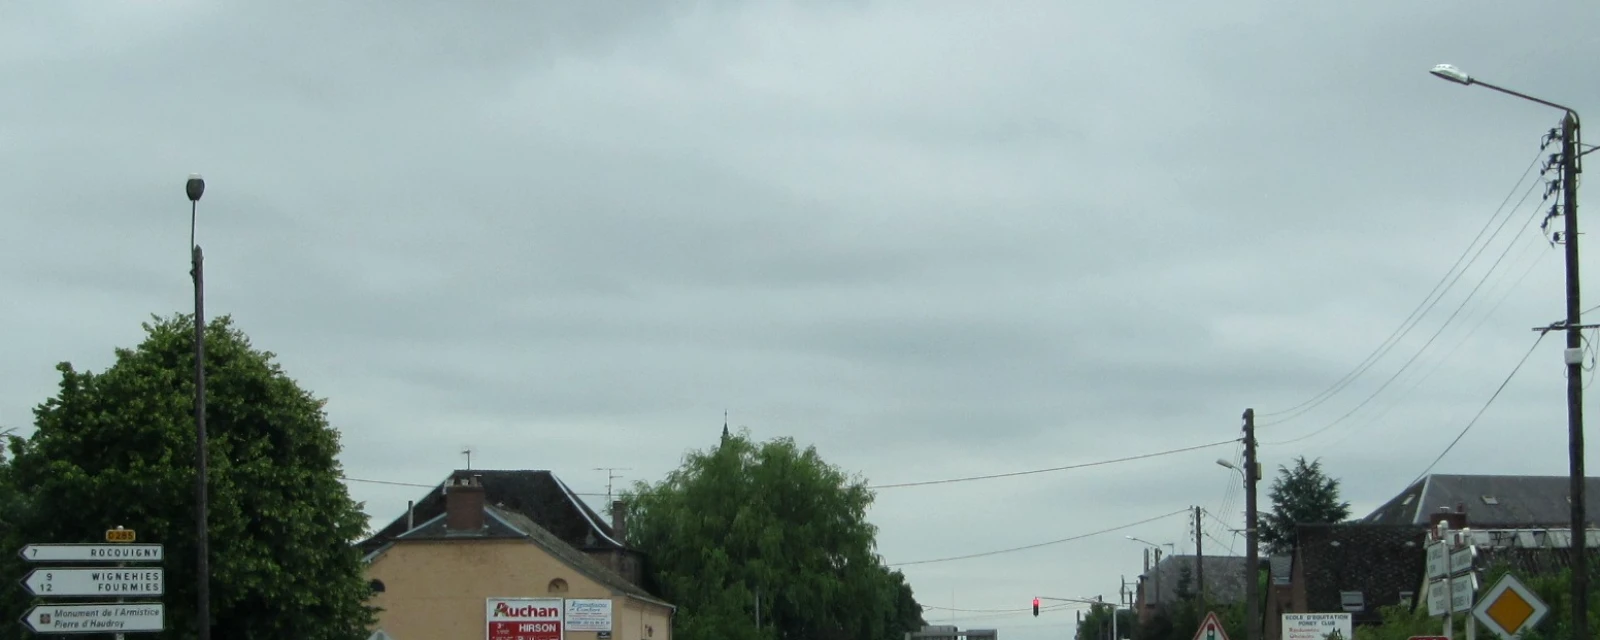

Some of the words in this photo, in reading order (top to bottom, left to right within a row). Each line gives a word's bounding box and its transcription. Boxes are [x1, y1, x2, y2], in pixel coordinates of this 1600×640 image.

[32, 549, 38, 557] 7
[91, 549, 158, 557] ROCQUIGNY
[46, 573, 53, 581] 9
[92, 573, 159, 581] WIGNEHIES
[40, 584, 52, 592] 12
[98, 583, 159, 591] FOURMIES
[54, 609, 99, 617] Monument
[102, 609, 112, 617] de
[115, 608, 160, 616] l'Armistice
[493, 602, 559, 617] Auchan
[54, 620, 79, 628] Pierre
[82, 619, 125, 629] d'Haudroy
[519, 623, 557, 632] HIRSON
